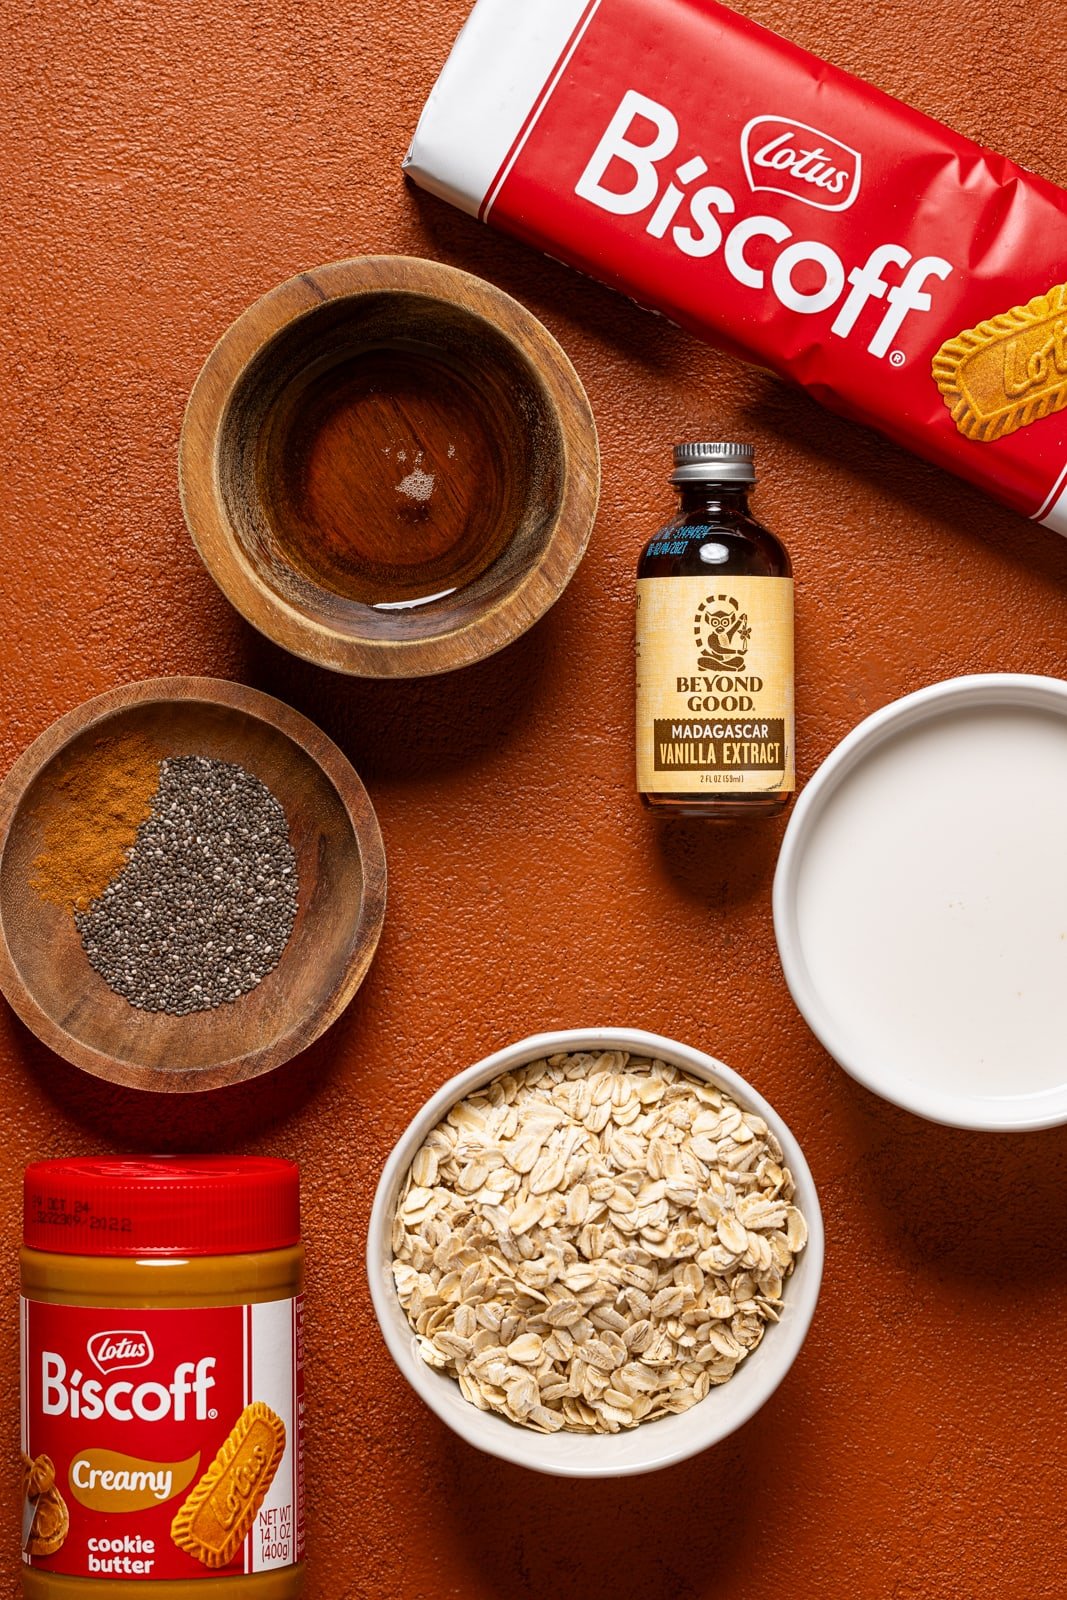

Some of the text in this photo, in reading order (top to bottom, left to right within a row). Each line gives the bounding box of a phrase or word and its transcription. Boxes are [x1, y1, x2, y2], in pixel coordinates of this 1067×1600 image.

[754, 131, 849, 193] Lotus
[574, 89, 953, 359] Biscoff
[676, 674, 763, 693] BEYOND
[671, 724, 769, 739] MADAGASCAR
[659, 742, 780, 764] VANILLA EXTRACT
[700, 775, 704, 783] 2
[705, 775, 712, 783] FL
[713, 775, 722, 783] OZ
[97, 1337, 146, 1362] Lotus
[42, 1351, 216, 1422] Biscoff
[72, 1460, 173, 1500] Creamy
[259, 1504, 291, 1527] NET WT
[260, 1522, 291, 1544] 14.1 OZ
[87, 1536, 155, 1554] cookie
[261, 1539, 290, 1563] (400g)
[88, 1554, 155, 1574] butter
